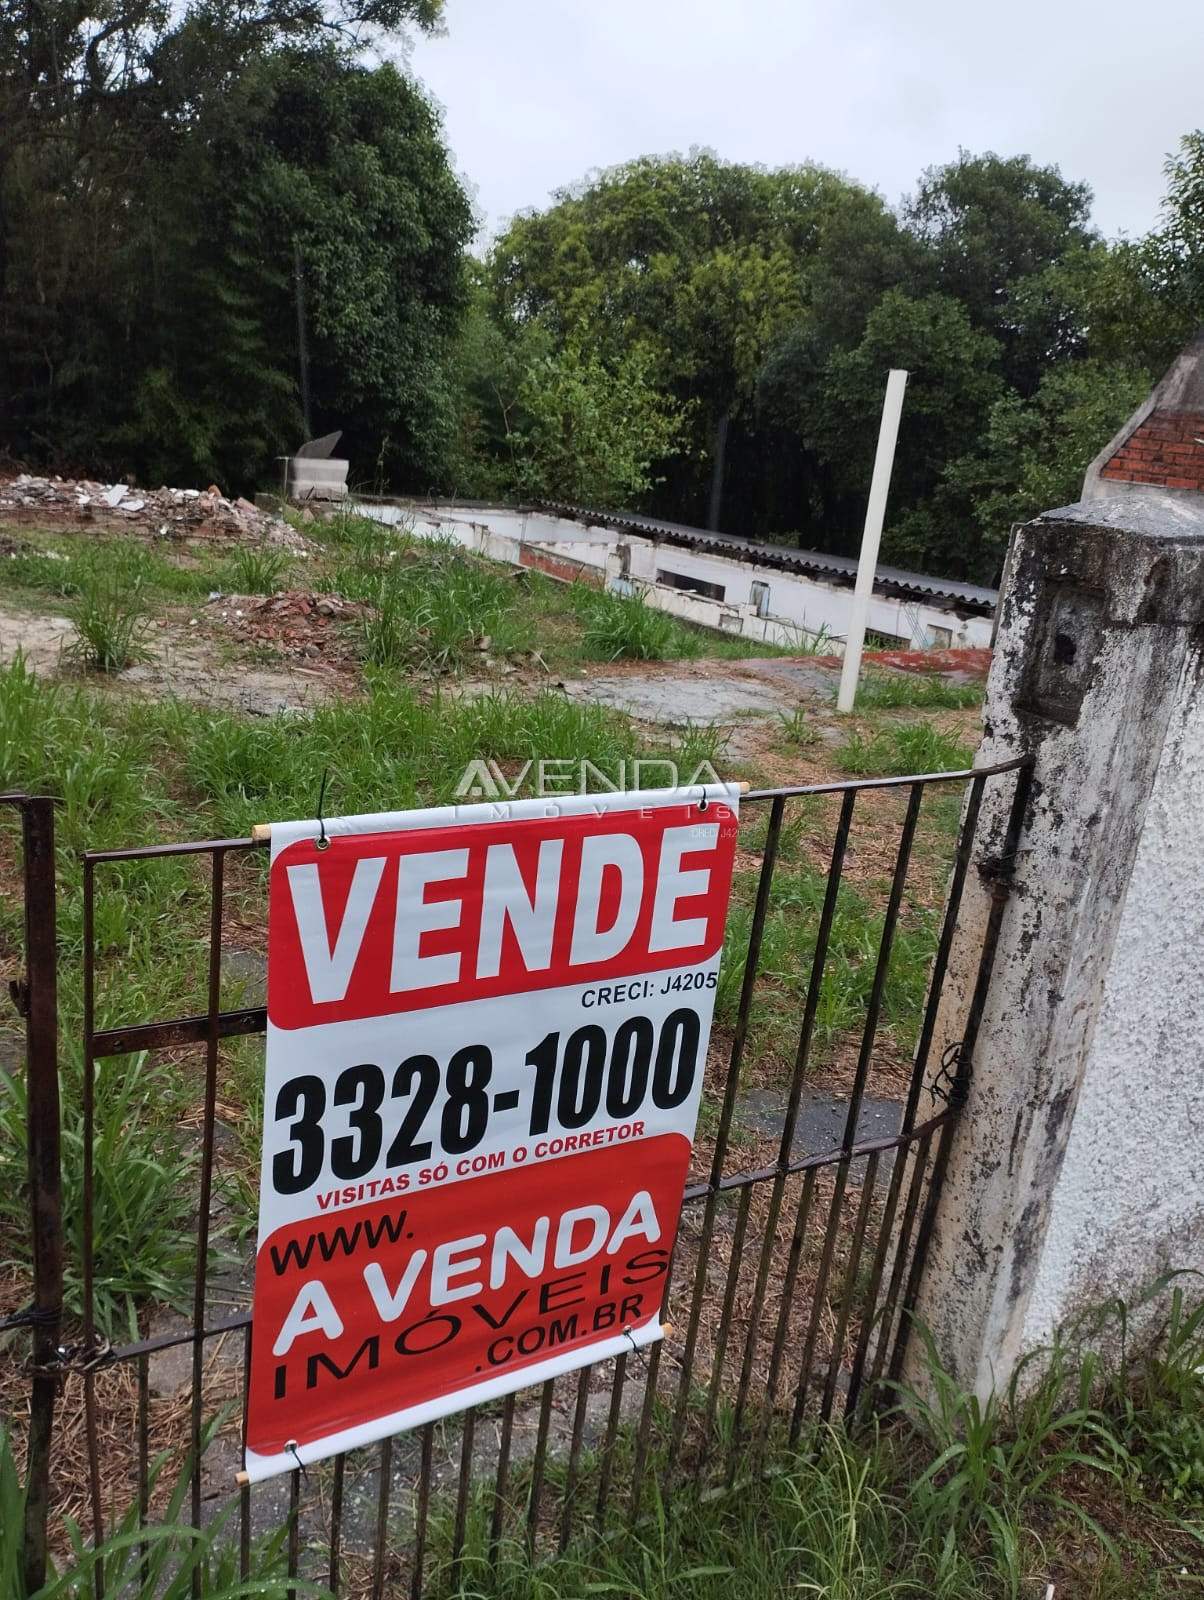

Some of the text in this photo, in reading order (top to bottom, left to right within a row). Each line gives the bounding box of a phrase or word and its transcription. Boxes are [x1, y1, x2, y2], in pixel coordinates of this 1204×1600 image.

[287, 822, 721, 1004] VENDE
[581, 972, 717, 1008] CRECI: J4205
[272, 1007, 700, 1195] 3328-1000
[316, 1121, 645, 1210] VISITAS SÓ COM O CORRETOR
[273, 1249, 669, 1399] IMÓVEIS
[474, 1293, 644, 1373] .COM.BR
